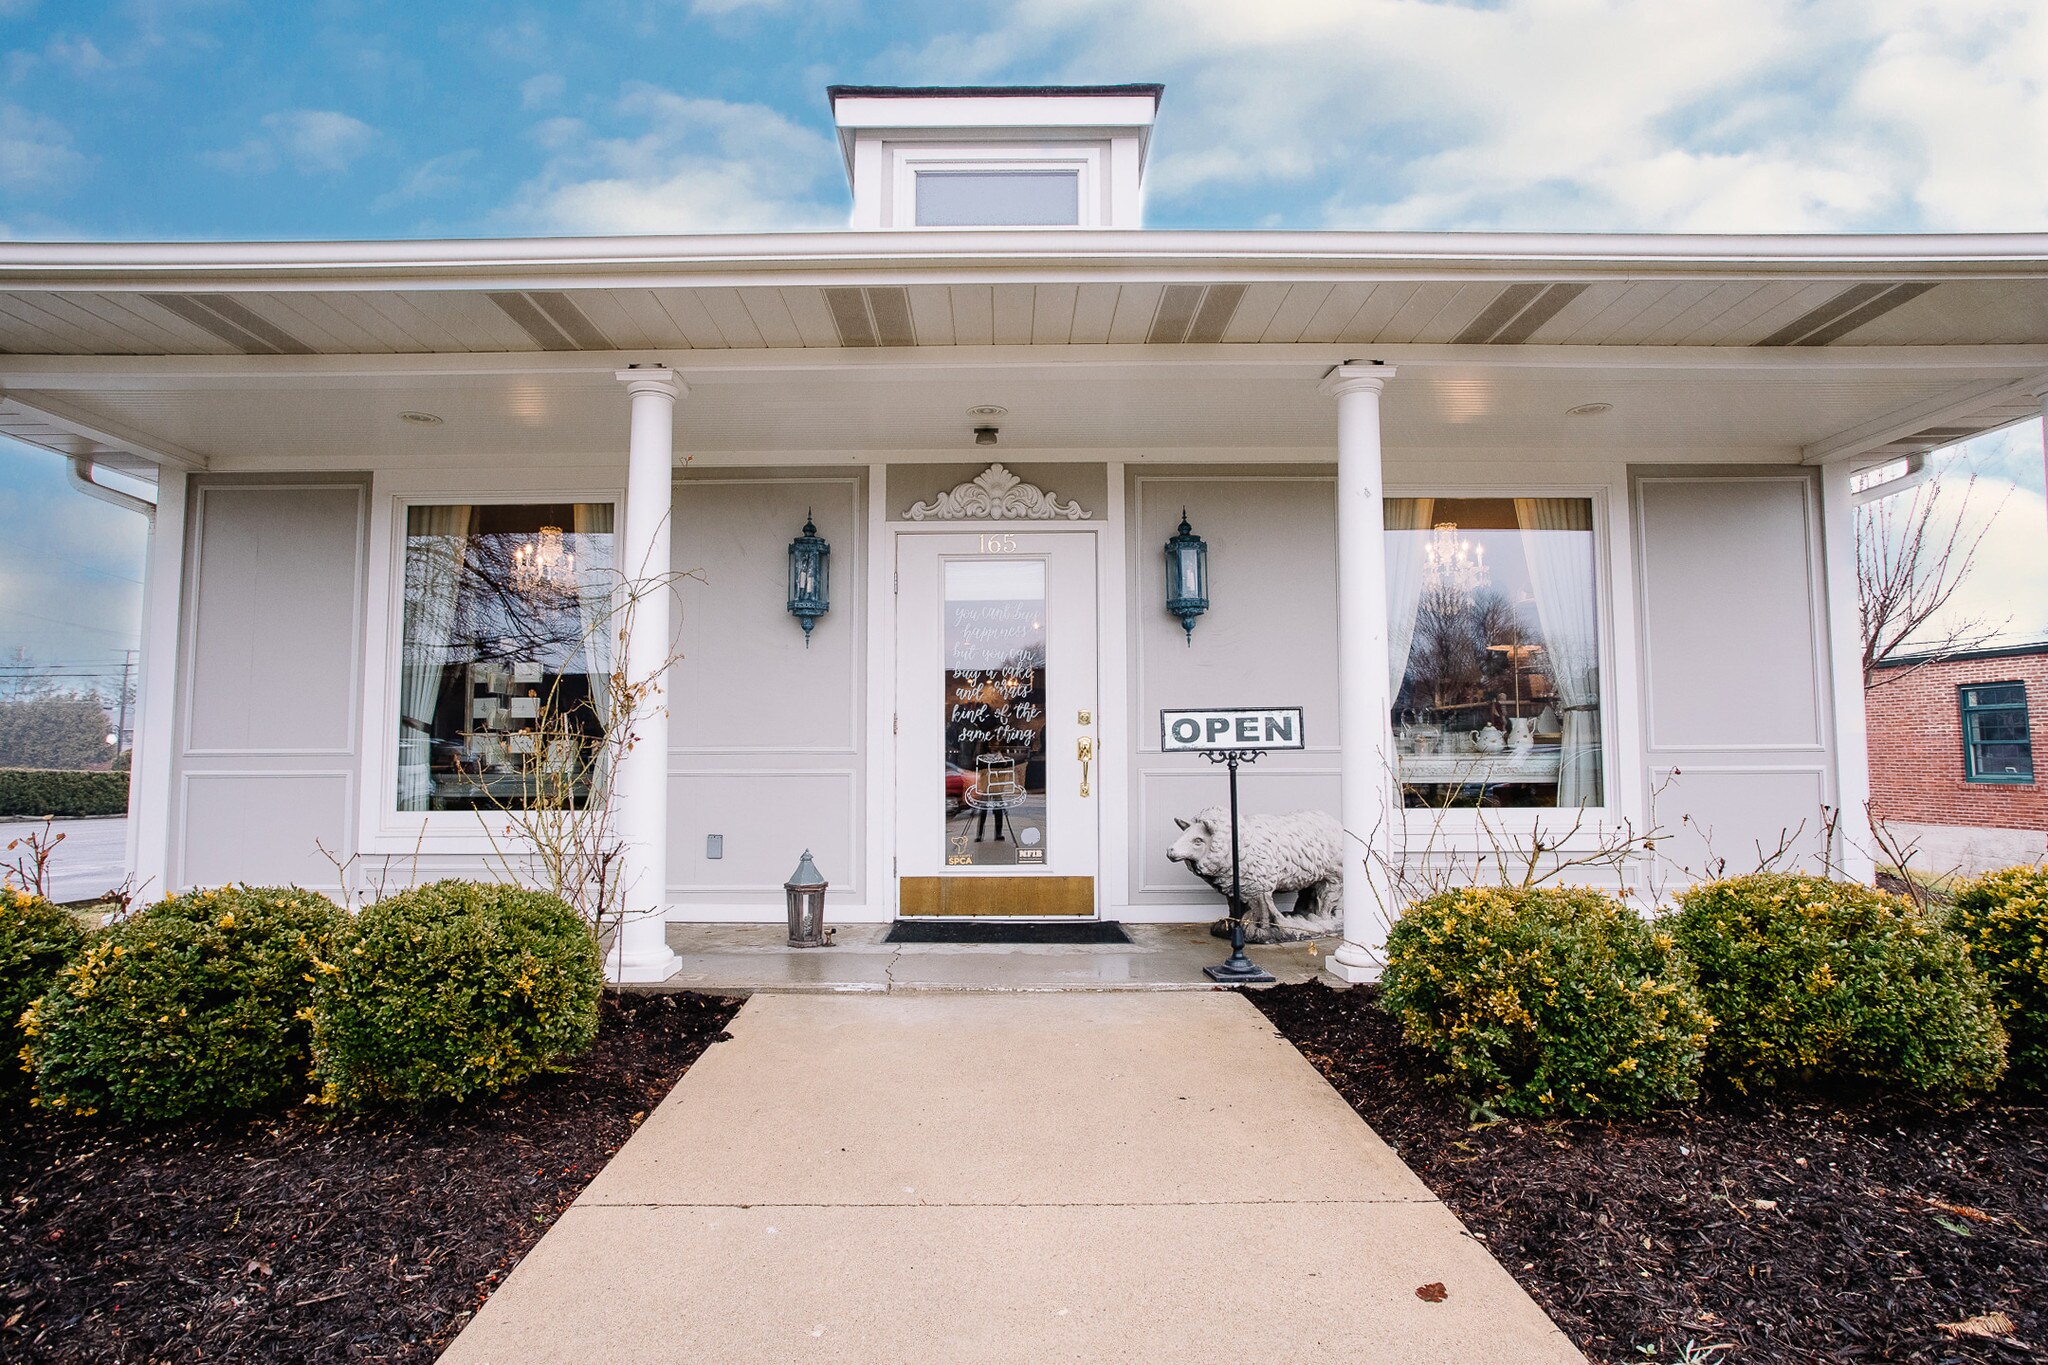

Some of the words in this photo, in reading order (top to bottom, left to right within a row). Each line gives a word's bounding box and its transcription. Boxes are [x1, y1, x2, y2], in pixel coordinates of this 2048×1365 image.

[980, 533, 1016, 554] 165
[953, 606, 981, 627] you
[962, 623, 1026, 642] happiness
[952, 641, 980, 660] but
[982, 648, 1008, 666] you
[1009, 648, 1035, 662] can
[953, 661, 981, 687] buy
[986, 668, 998, 680] a
[1002, 662, 1034, 680] cake
[956, 683, 984, 700] and
[952, 704, 989, 722] kind
[994, 704, 1012, 725] of
[1014, 702, 1042, 722] the
[958, 727, 994, 742] same
[1171, 717, 1293, 743] OPEN
[949, 857, 973, 865] SPCA
